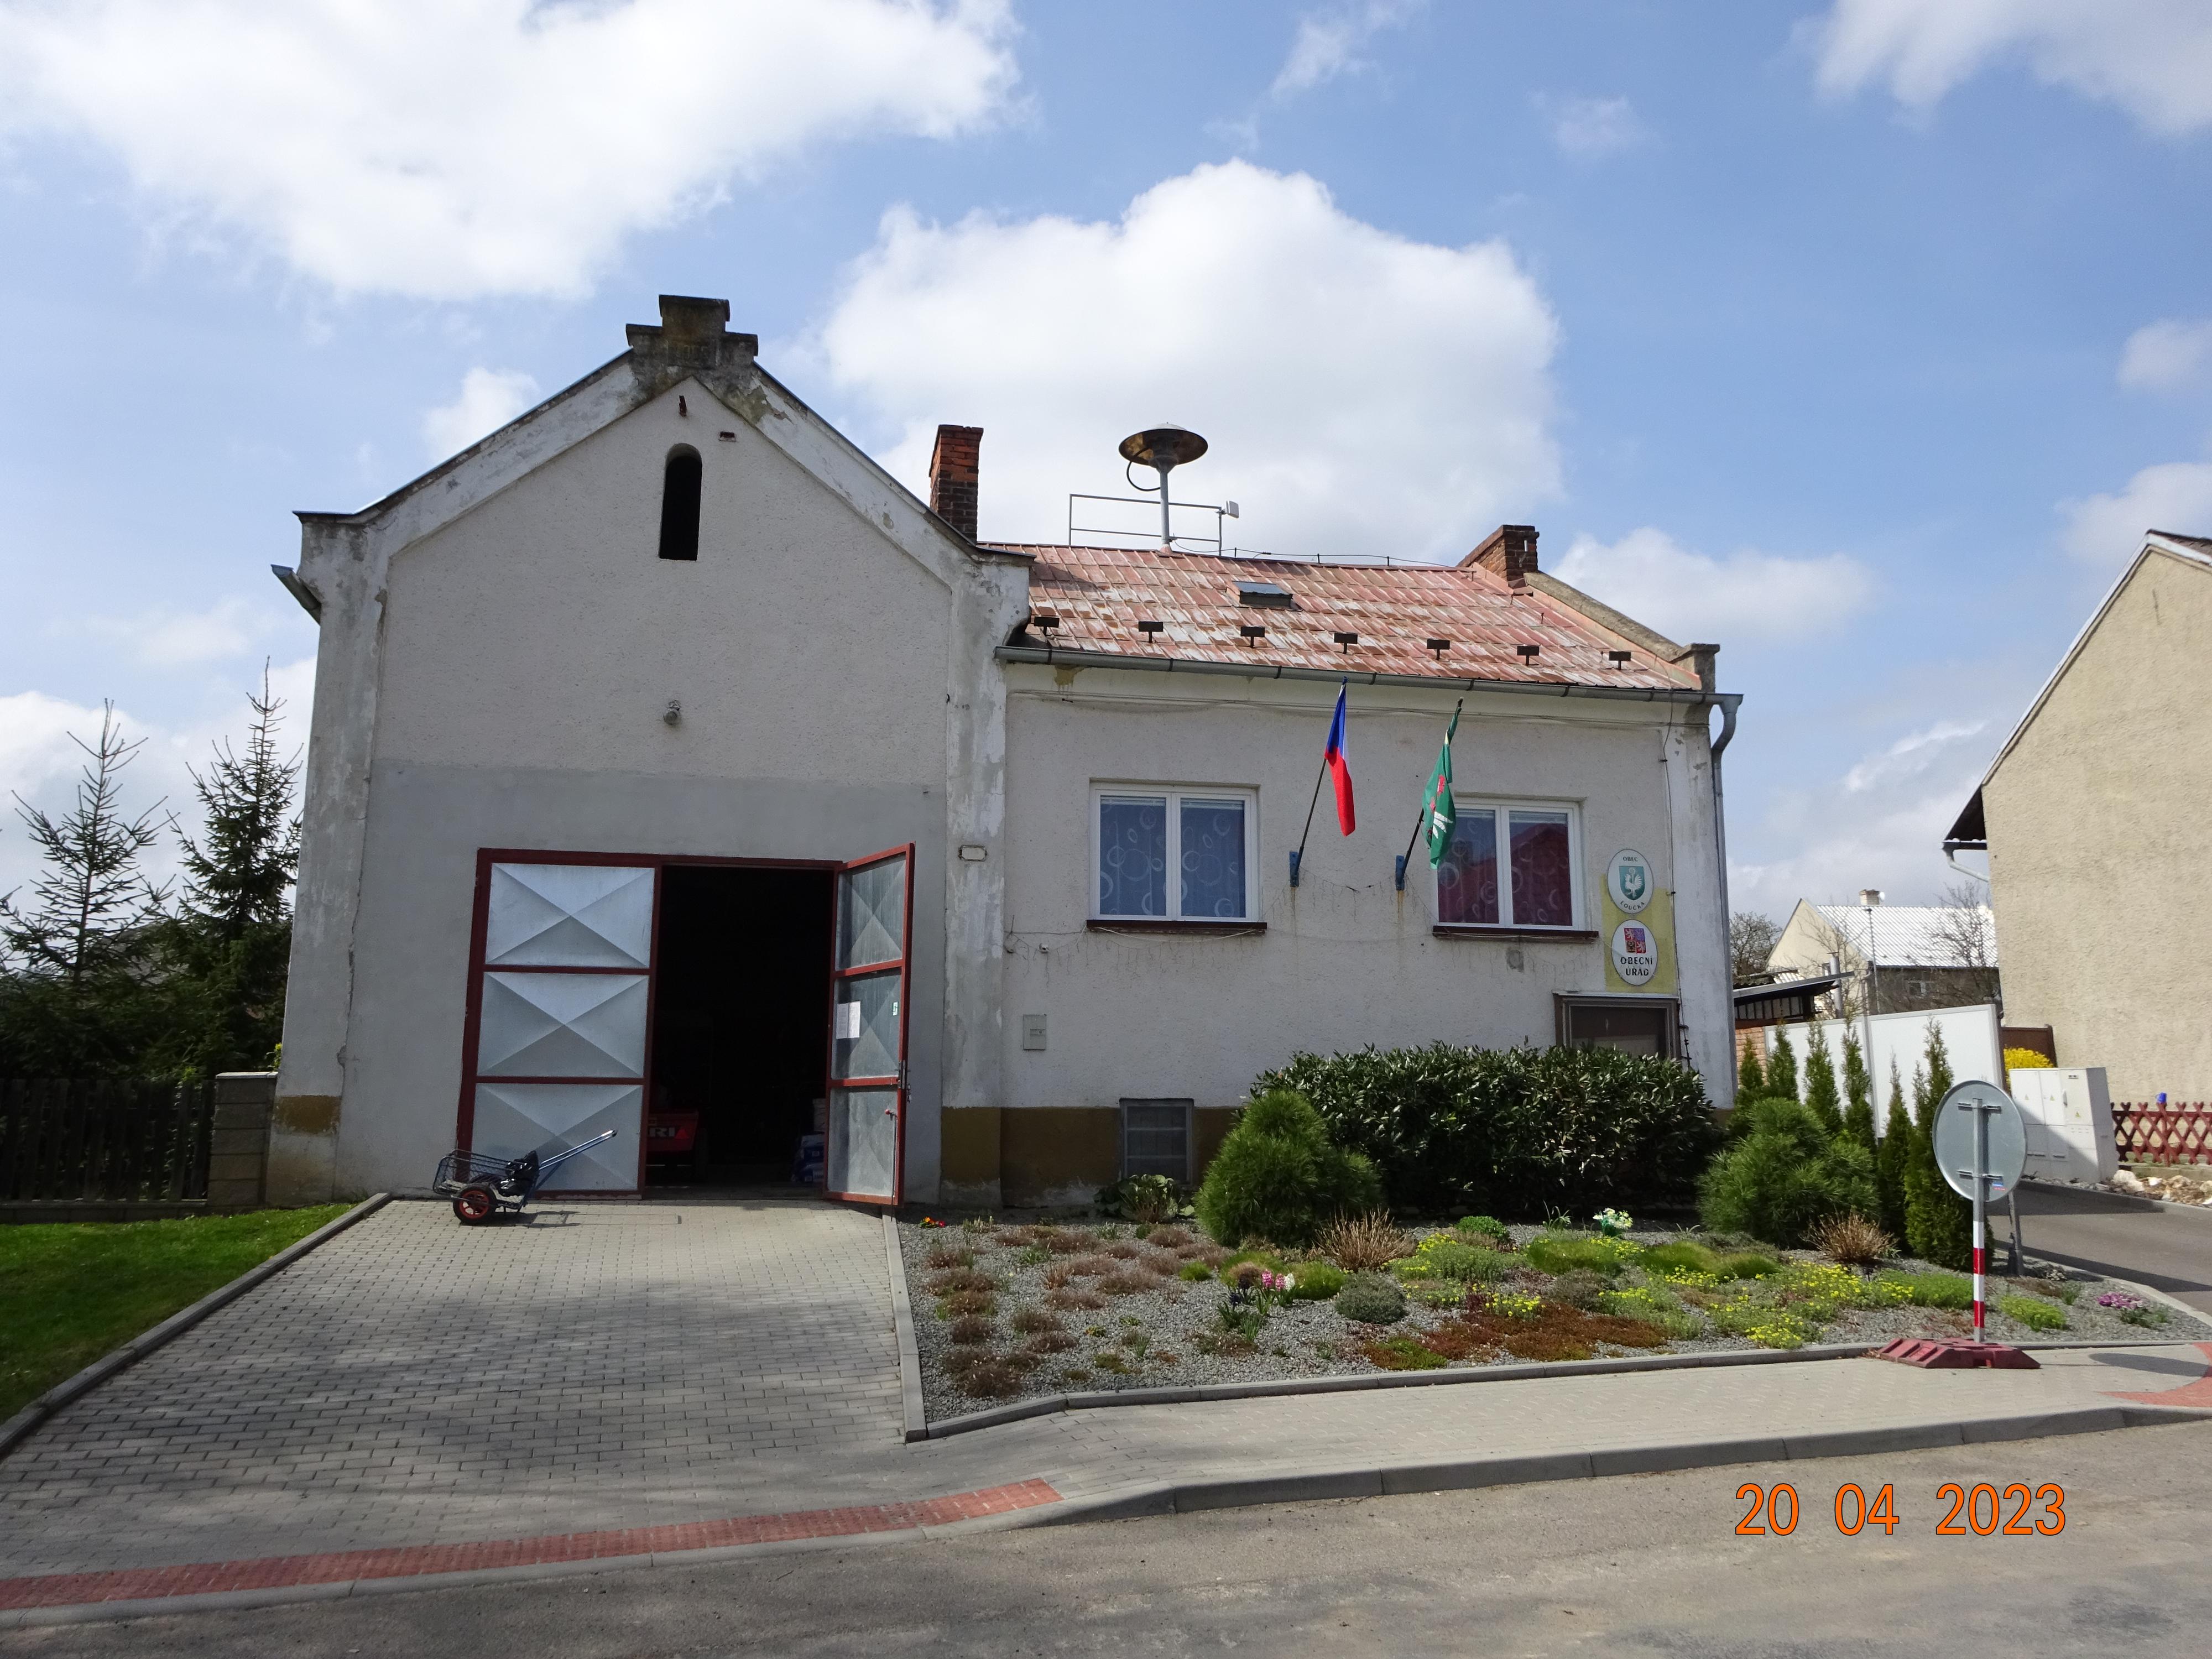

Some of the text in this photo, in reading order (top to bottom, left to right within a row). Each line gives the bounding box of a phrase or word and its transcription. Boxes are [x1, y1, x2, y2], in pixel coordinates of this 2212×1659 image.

[1620, 956, 1652, 964] OBECNÍ
[1626, 966, 1649, 976] ÚŘAD
[647, 1127, 675, 1138] RI
